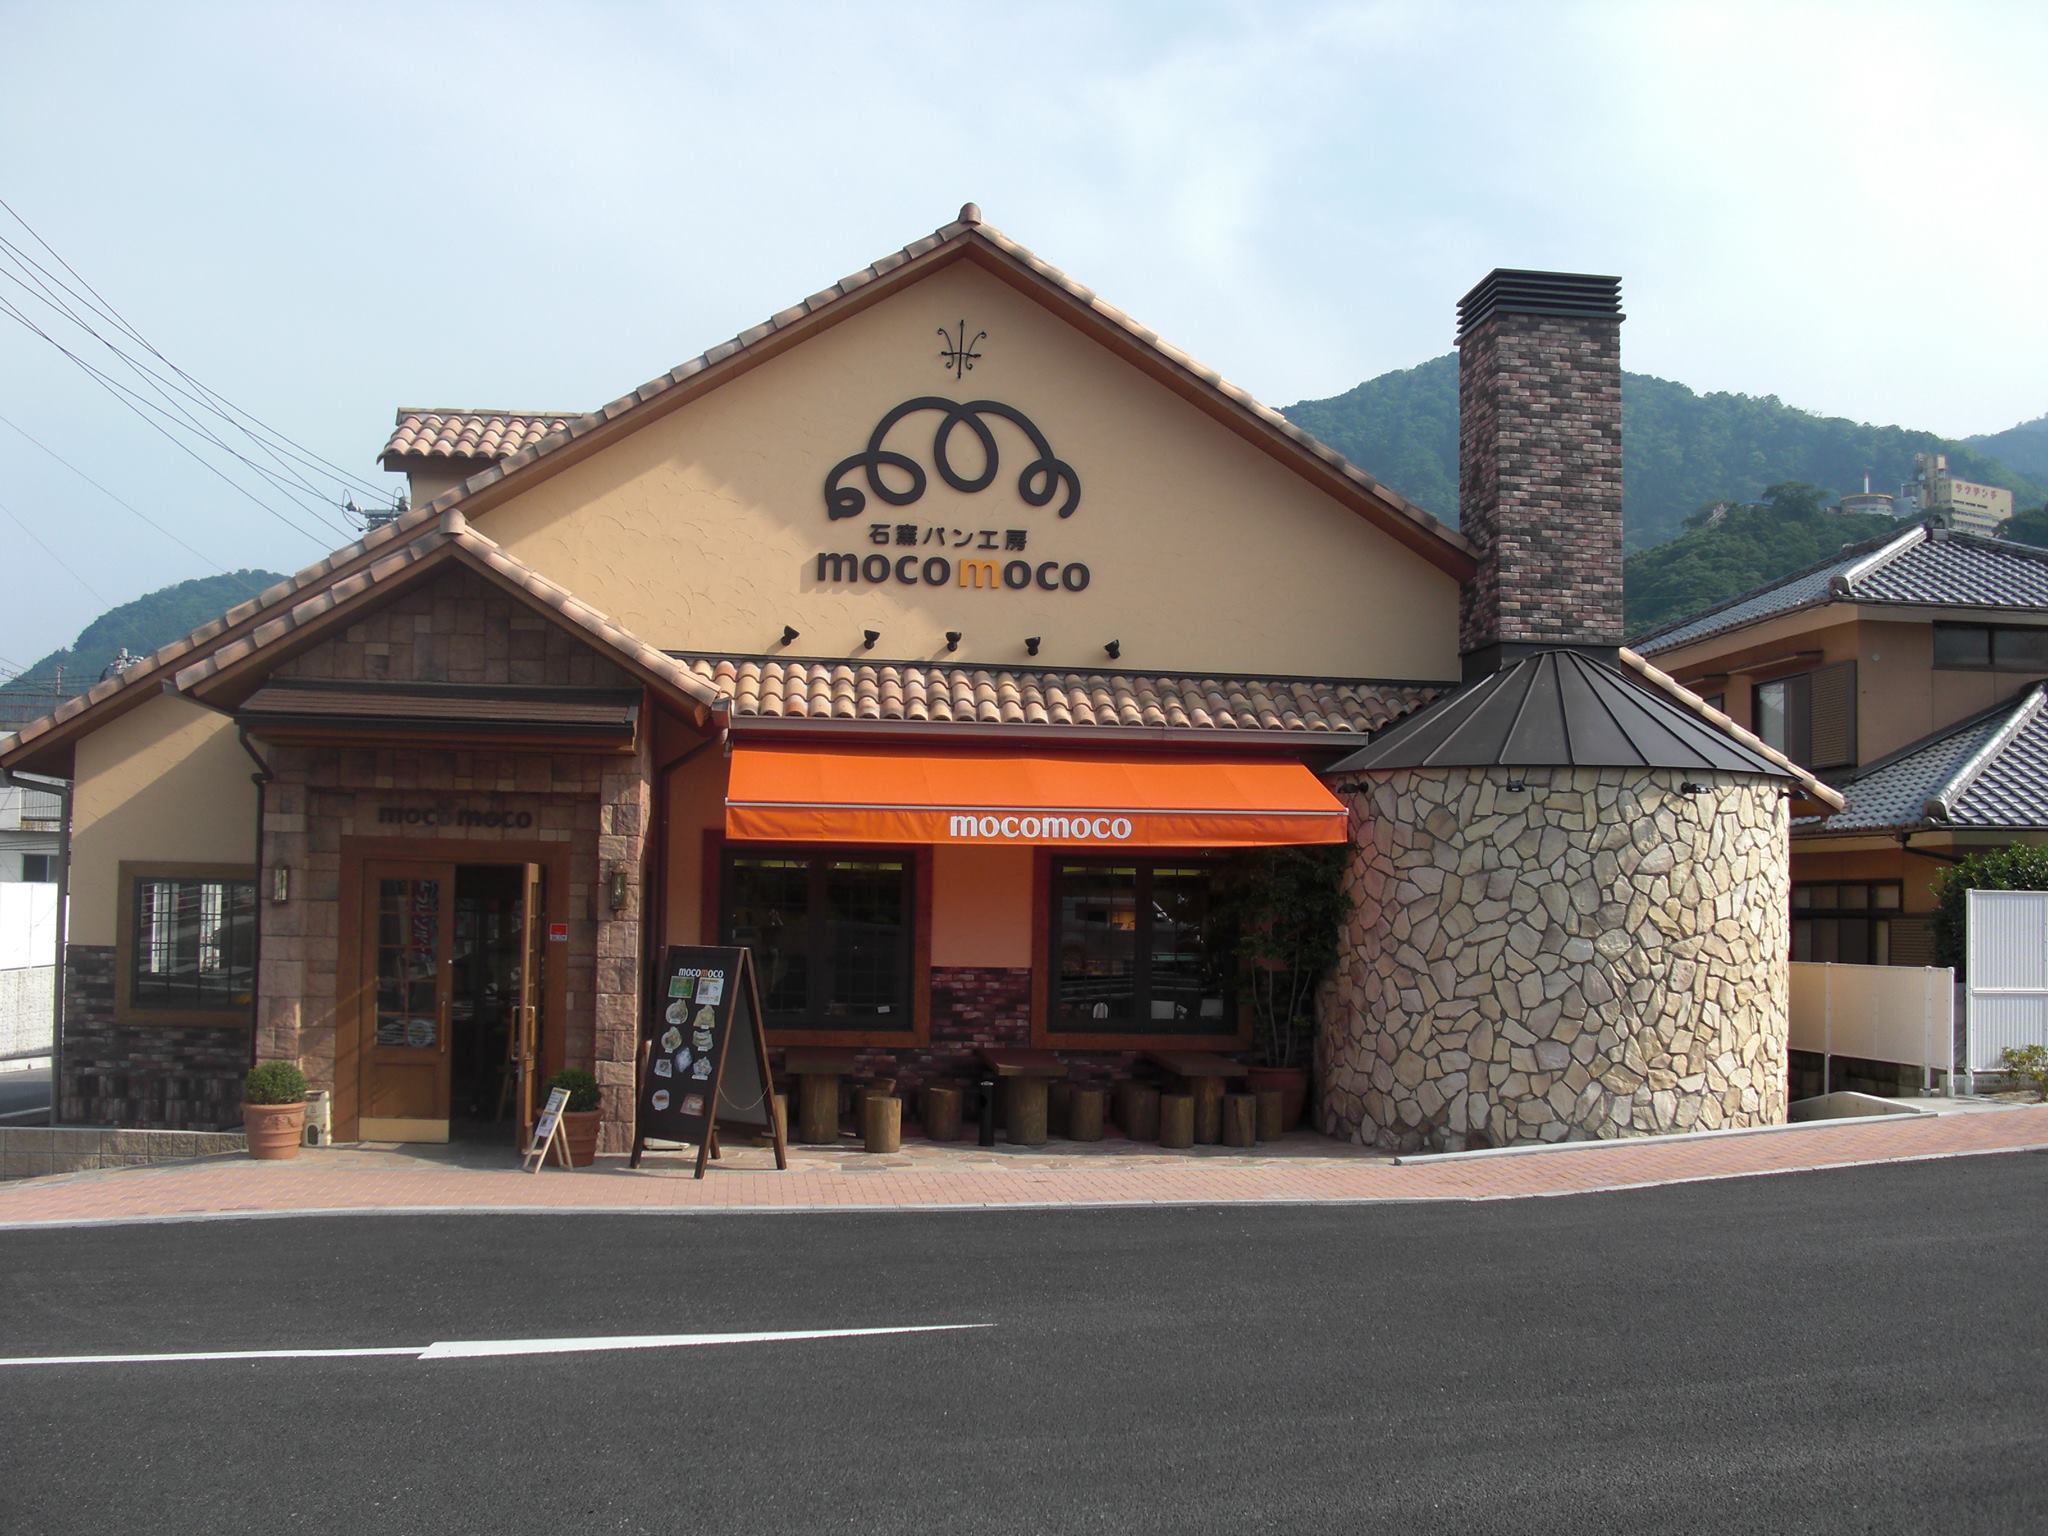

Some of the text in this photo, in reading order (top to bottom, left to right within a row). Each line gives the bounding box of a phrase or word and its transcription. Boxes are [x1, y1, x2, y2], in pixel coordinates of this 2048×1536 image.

[869, 524, 1028, 551] 石窯パン工房
[949, 815, 1132, 839] mocomoco
